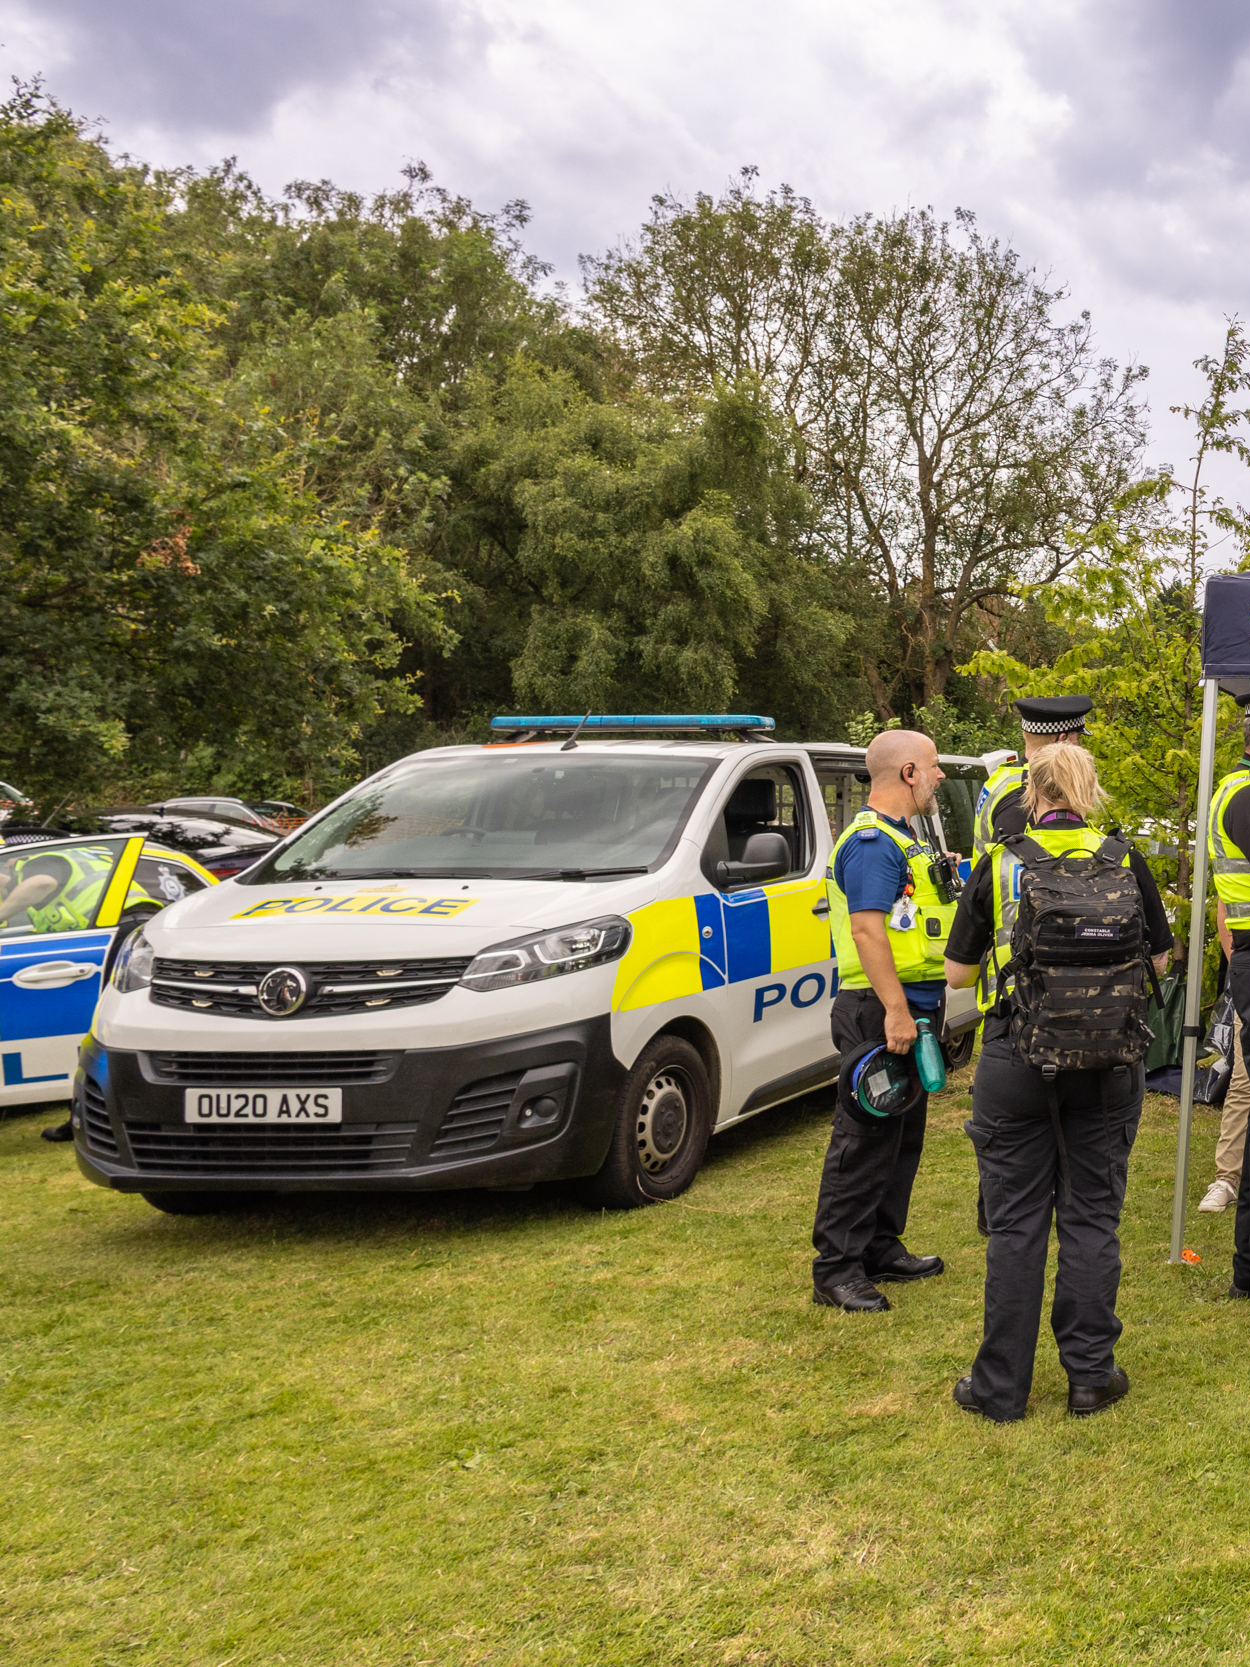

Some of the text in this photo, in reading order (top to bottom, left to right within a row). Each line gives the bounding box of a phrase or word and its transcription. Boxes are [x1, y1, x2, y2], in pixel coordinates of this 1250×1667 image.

[240, 897, 471, 916] POLICE
[2, 1046, 80, 1086] L
[197, 1093, 329, 1118] OU20 AXS
